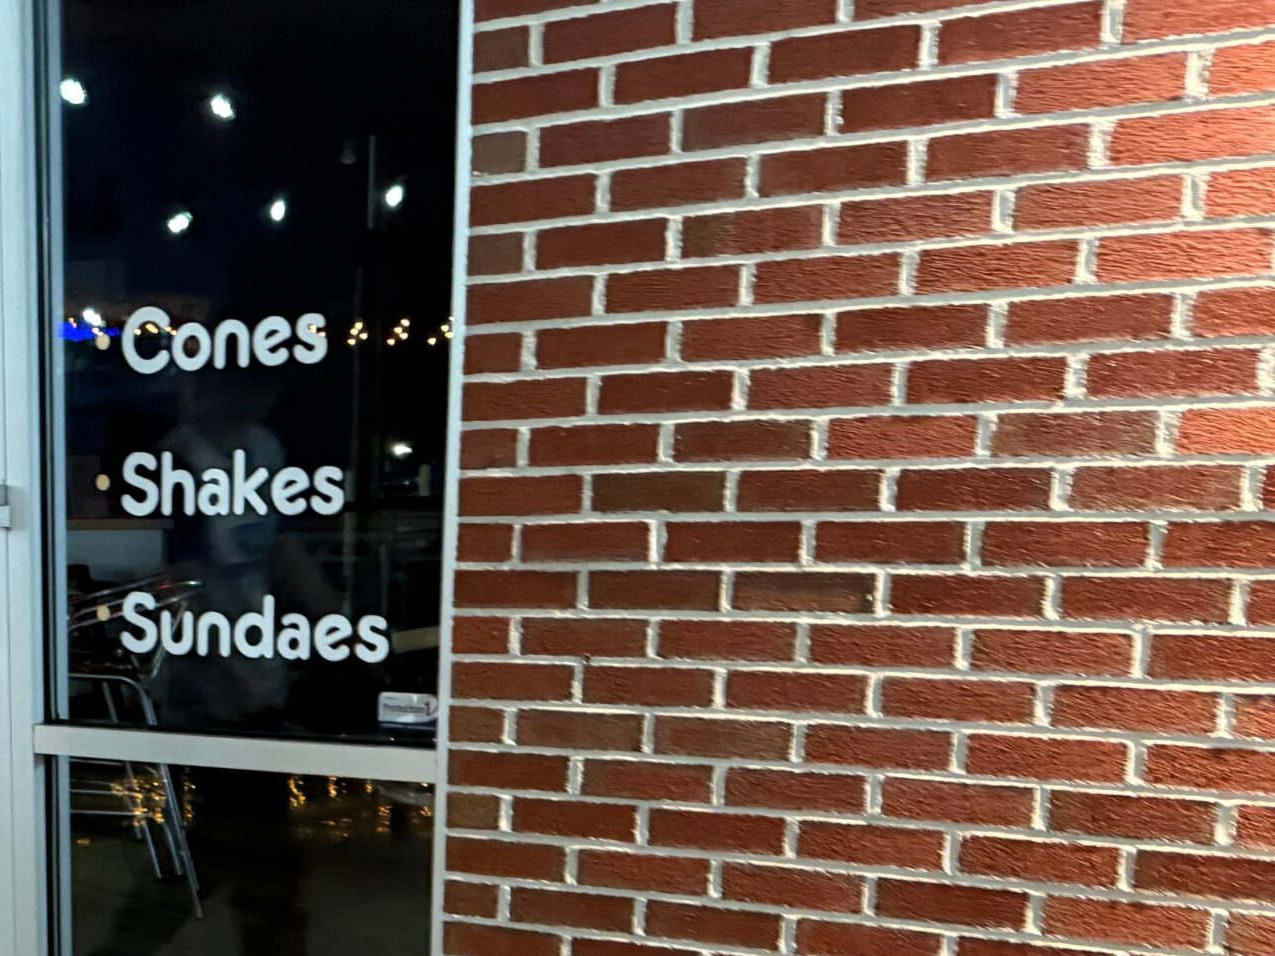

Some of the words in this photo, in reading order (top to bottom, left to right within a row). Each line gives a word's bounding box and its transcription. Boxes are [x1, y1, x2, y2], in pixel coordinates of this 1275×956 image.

[121, 306, 328, 374] Cones
[121, 448, 345, 517] Shakes
[119, 591, 390, 663] Sundaes
